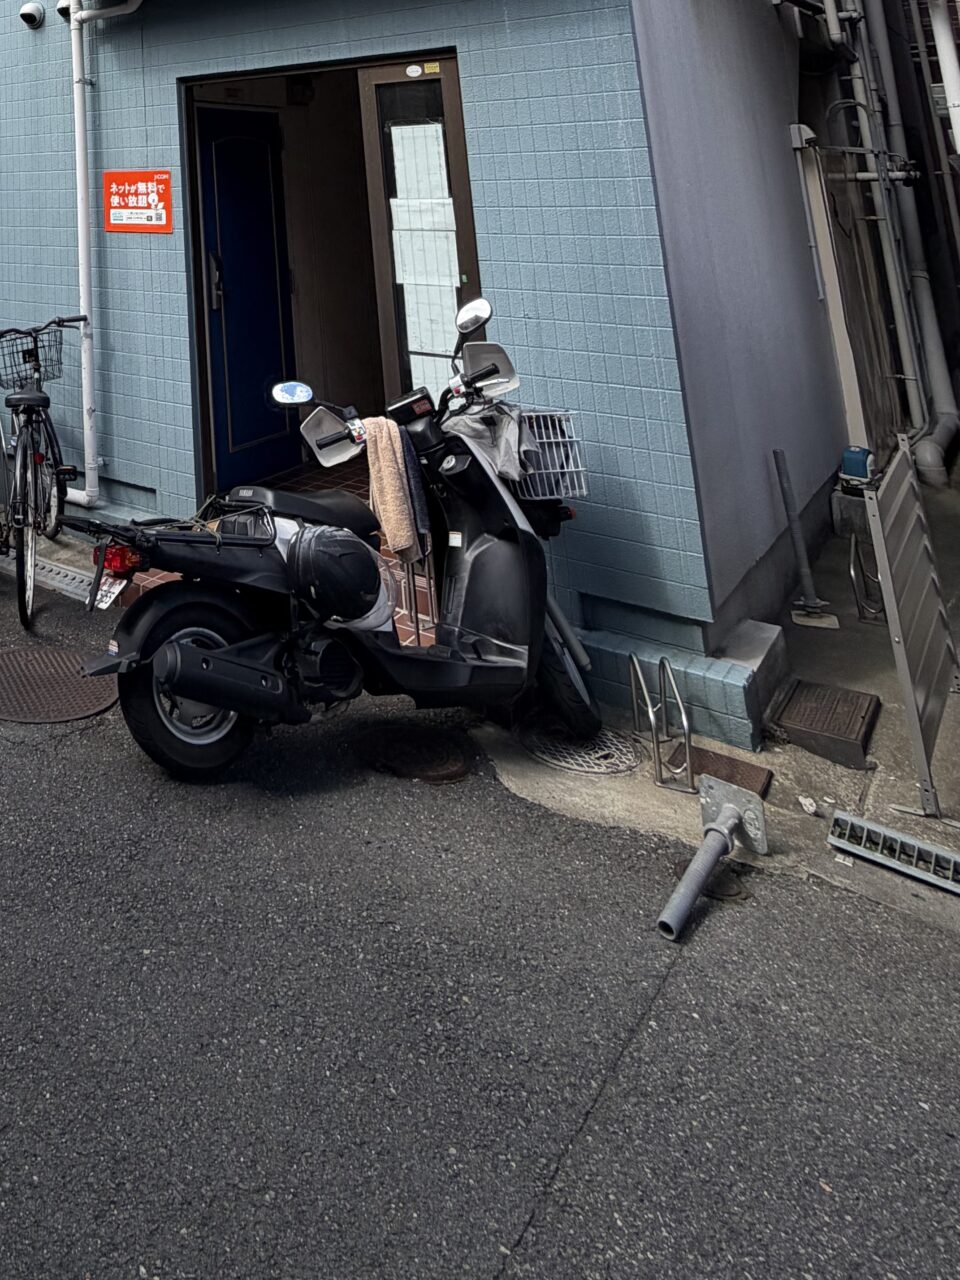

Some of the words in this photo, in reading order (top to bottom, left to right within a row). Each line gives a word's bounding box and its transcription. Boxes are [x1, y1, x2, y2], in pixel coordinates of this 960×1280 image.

[110, 182, 165, 193] ネットが無料で
[110, 195, 147, 207] 使い放題
